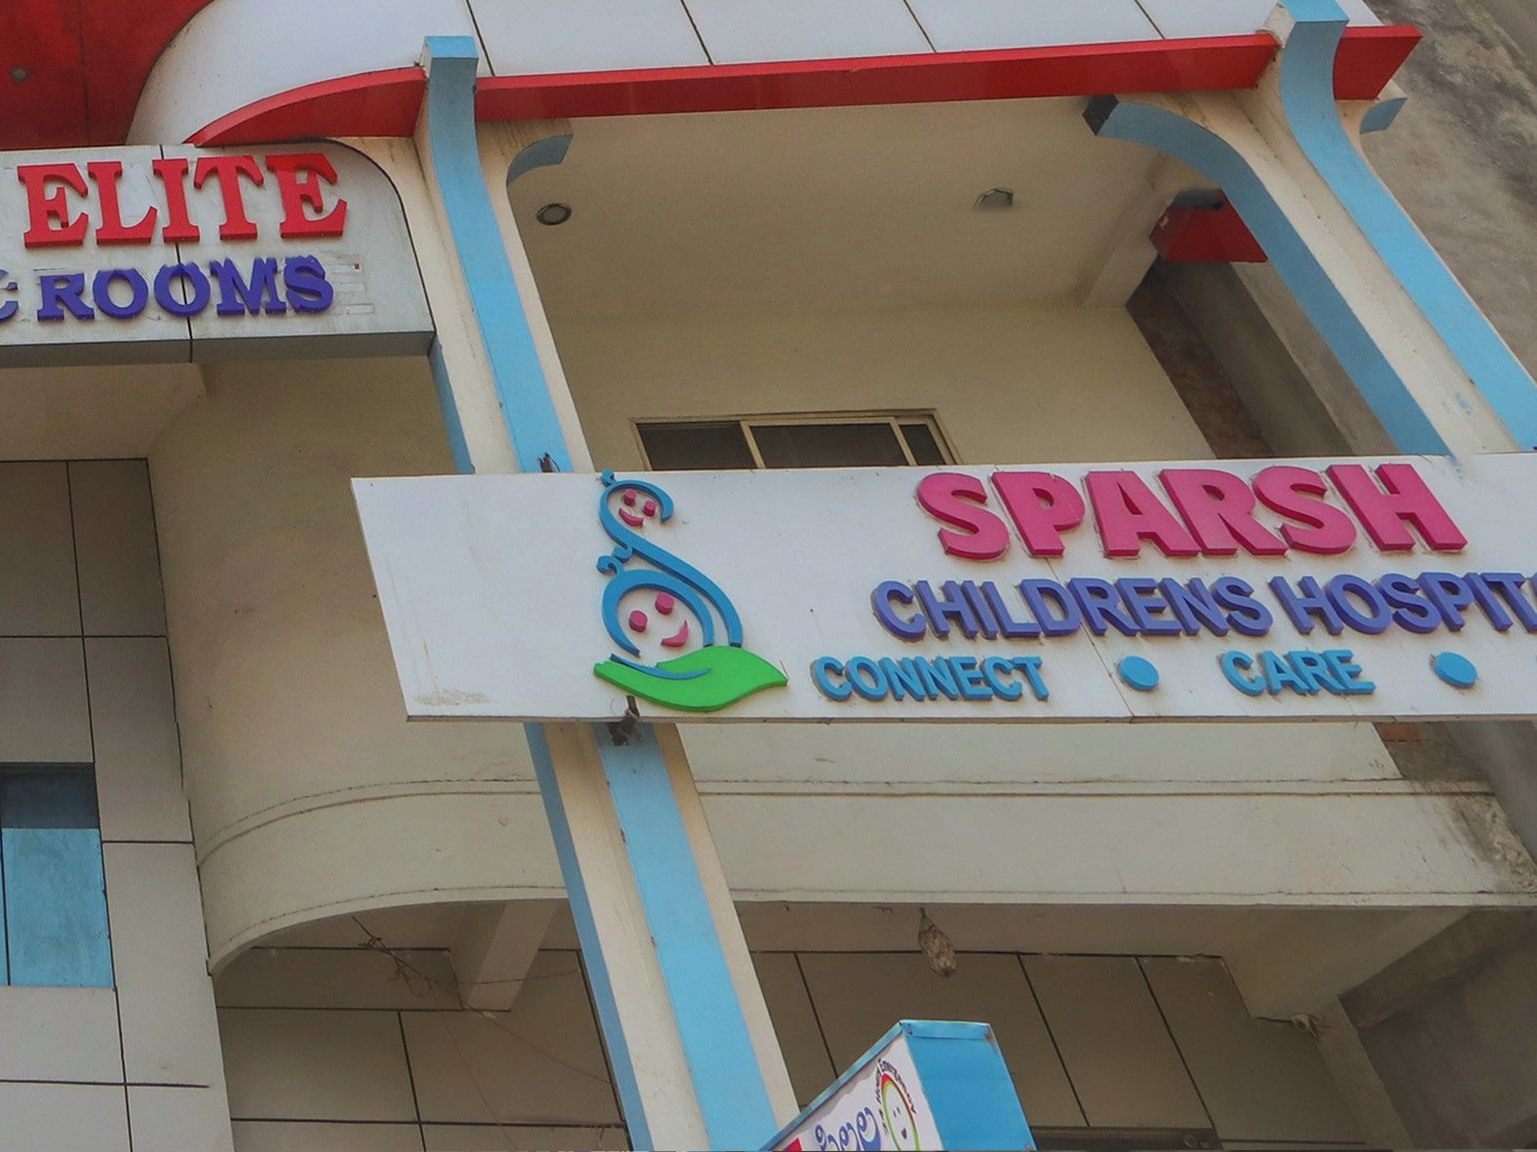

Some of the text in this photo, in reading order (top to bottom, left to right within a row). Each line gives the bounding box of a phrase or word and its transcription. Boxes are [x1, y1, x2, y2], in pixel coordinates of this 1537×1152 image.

[18, 153, 348, 247] ELITE
[37, 254, 335, 322] ROOMS
[917, 464, 1468, 561] SPARSH
[872, 572, 1537, 640] CHILDRENS HOSPIT
[812, 649, 1376, 701] CONNECT CARE
